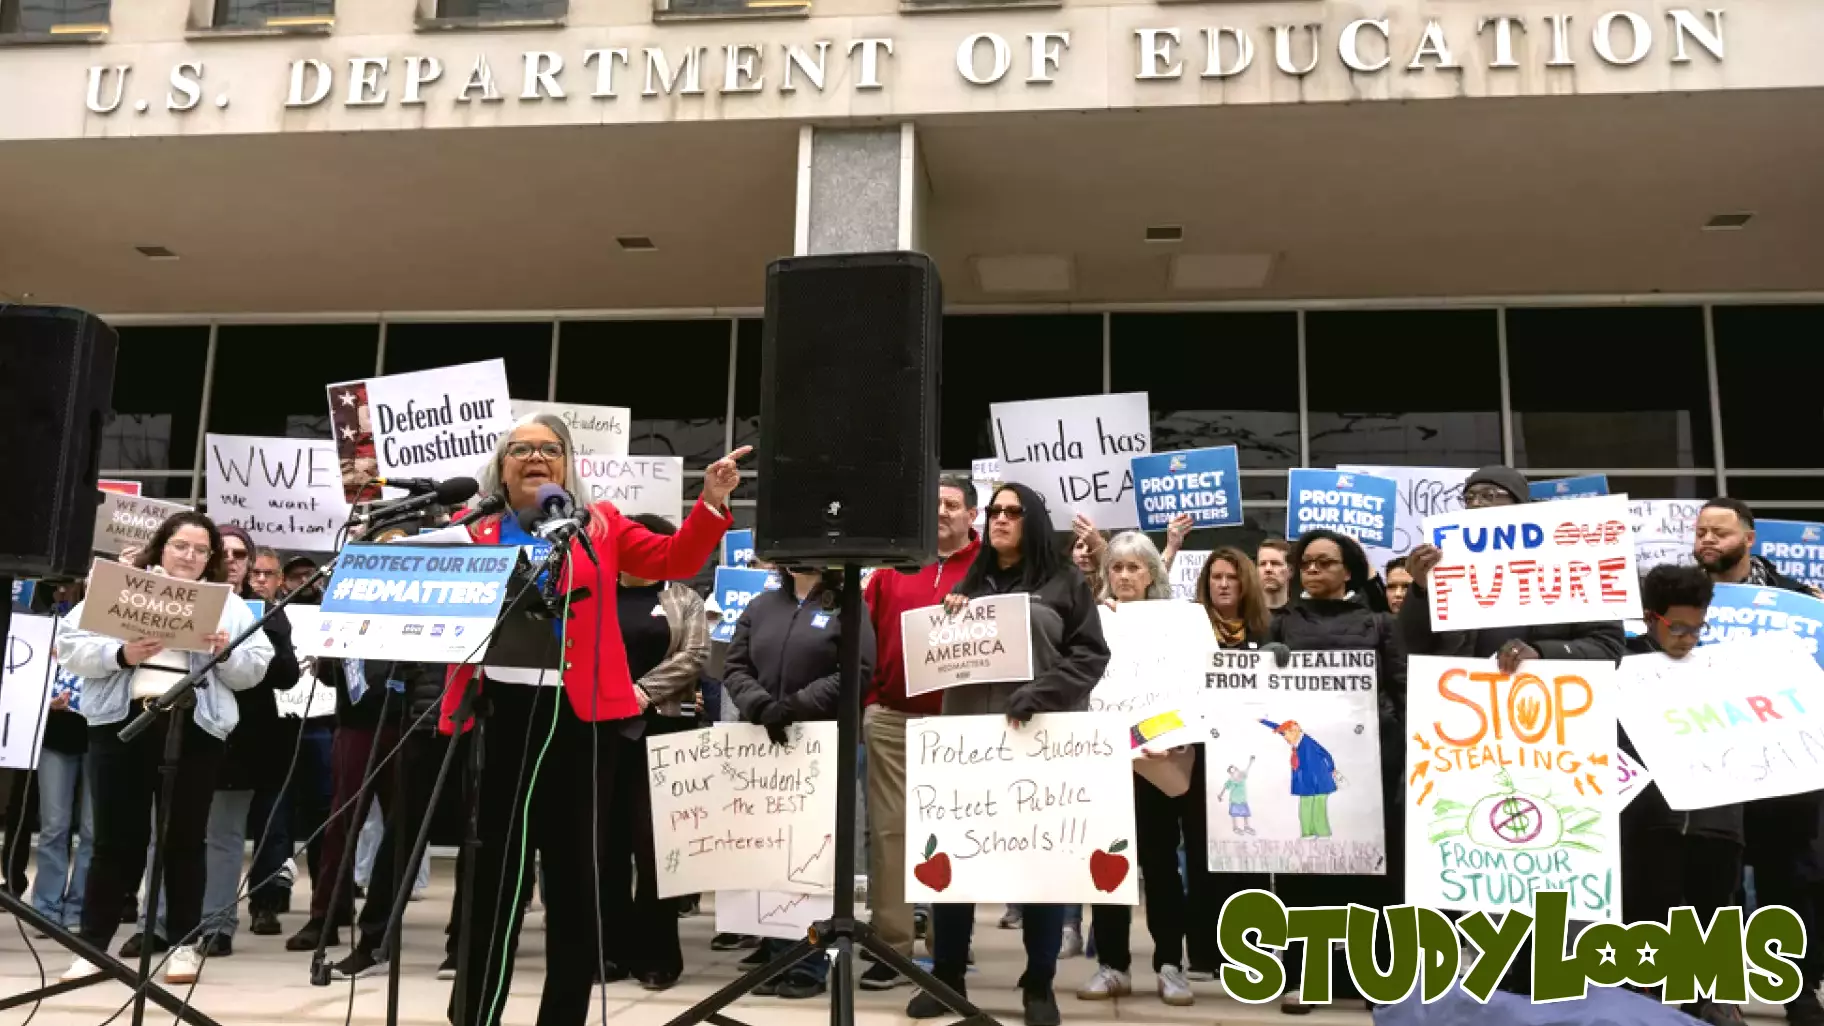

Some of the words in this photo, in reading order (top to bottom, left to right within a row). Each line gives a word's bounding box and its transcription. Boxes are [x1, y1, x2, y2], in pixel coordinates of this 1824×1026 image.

[86, 62, 230, 112] U.S.
[283, 37, 894, 107] DEPARTMENT
[956, 31, 1071, 86] OF
[1134, 8, 1726, 80] EDUCATION
[376, 393, 453, 435] Defend
[459, 398, 495, 422] our
[562, 411, 622, 435] Students
[383, 425, 502, 468] Constitutio
[996, 418, 1083, 463] Linda
[1096, 416, 1146, 456] has
[213, 444, 334, 489] WWE
[577, 457, 671, 481] DUCATE
[1059, 470, 1134, 503] IDEA
[1140, 470, 1224, 495] PROTECT
[115, 498, 138, 511] WE
[141, 503, 168, 518] ARE
[268, 497, 320, 511] want
[1143, 494, 1177, 512] OUR
[1181, 489, 1228, 509] KIDS
[1299, 489, 1385, 512] PROTECT
[112, 510, 164, 529] SOMO
[1298, 507, 1340, 524] OUR
[1343, 509, 1385, 529] KIDS
[1433, 522, 1545, 553] FUND
[1553, 519, 1627, 547] OUR
[340, 553, 424, 572] PROTECT
[426, 556, 464, 573] OUR
[466, 557, 509, 574] KIDS
[1776, 560, 1806, 577] UR
[124, 574, 157, 595] WE
[160, 585, 198, 602] ARE
[332, 577, 500, 605] #EDMATTERS
[1433, 556, 1627, 620] FUTURE
[108, 603, 194, 631] AMERICA
[118, 589, 195, 617] SOMOS
[962, 604, 996, 622] ARE
[928, 621, 998, 646] SOMOS
[1705, 606, 1823, 636] PROTECT
[925, 639, 1005, 665] AMERICA
[1212, 653, 1261, 669] STOP
[1289, 651, 1374, 669] TEALING
[1205, 672, 1257, 689] FROM
[1268, 674, 1372, 691] STUDENTS
[1433, 667, 1594, 747] STOP
[1663, 687, 1807, 736] SMART
[651, 732, 797, 770] Investment
[806, 739, 821, 756] in
[919, 729, 1014, 766] Protect
[1026, 728, 1114, 762] Students
[1434, 744, 1583, 773] STEALING
[671, 774, 715, 797] our
[733, 767, 816, 795] Students
[670, 805, 708, 832] pays
[765, 794, 807, 814] BEST
[911, 783, 998, 823] Protect
[1007, 778, 1092, 814] Public
[688, 827, 787, 857] Interest
[952, 816, 1088, 860] Schools!!!
[1439, 840, 1508, 870] FROM
[1513, 848, 1573, 875] OUR
